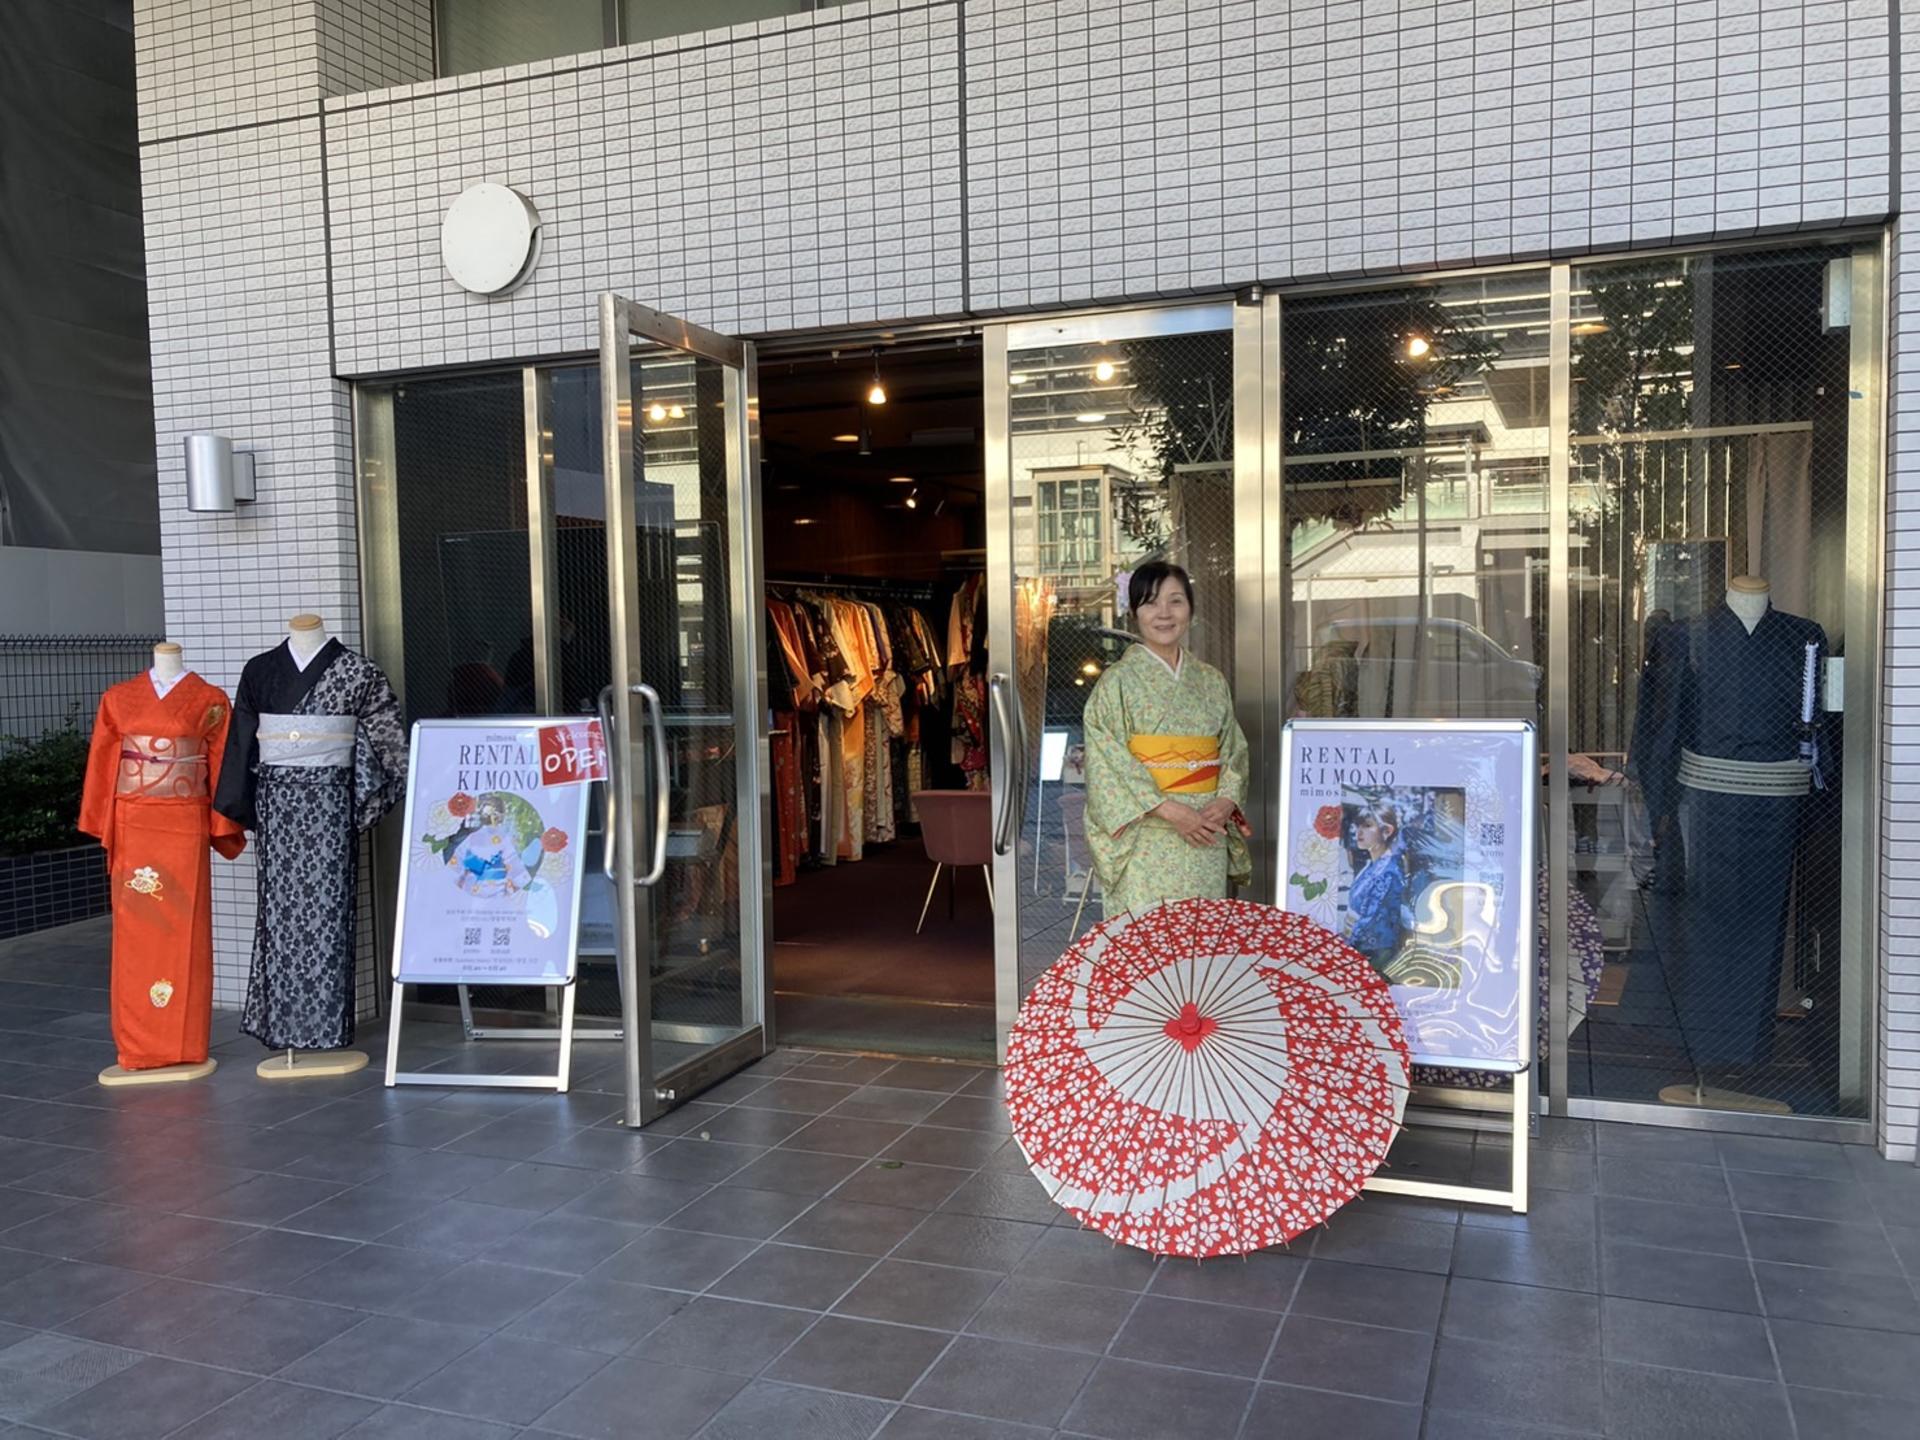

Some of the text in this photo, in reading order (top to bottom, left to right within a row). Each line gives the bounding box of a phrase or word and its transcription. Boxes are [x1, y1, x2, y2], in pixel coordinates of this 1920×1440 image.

[459, 744, 538, 766] RENTAL
[1301, 746, 1396, 765] RENTAL
[457, 770, 539, 791] KIMONO
[1300, 767, 1396, 788] KIMONO
[1300, 786, 1348, 798] mimosa
